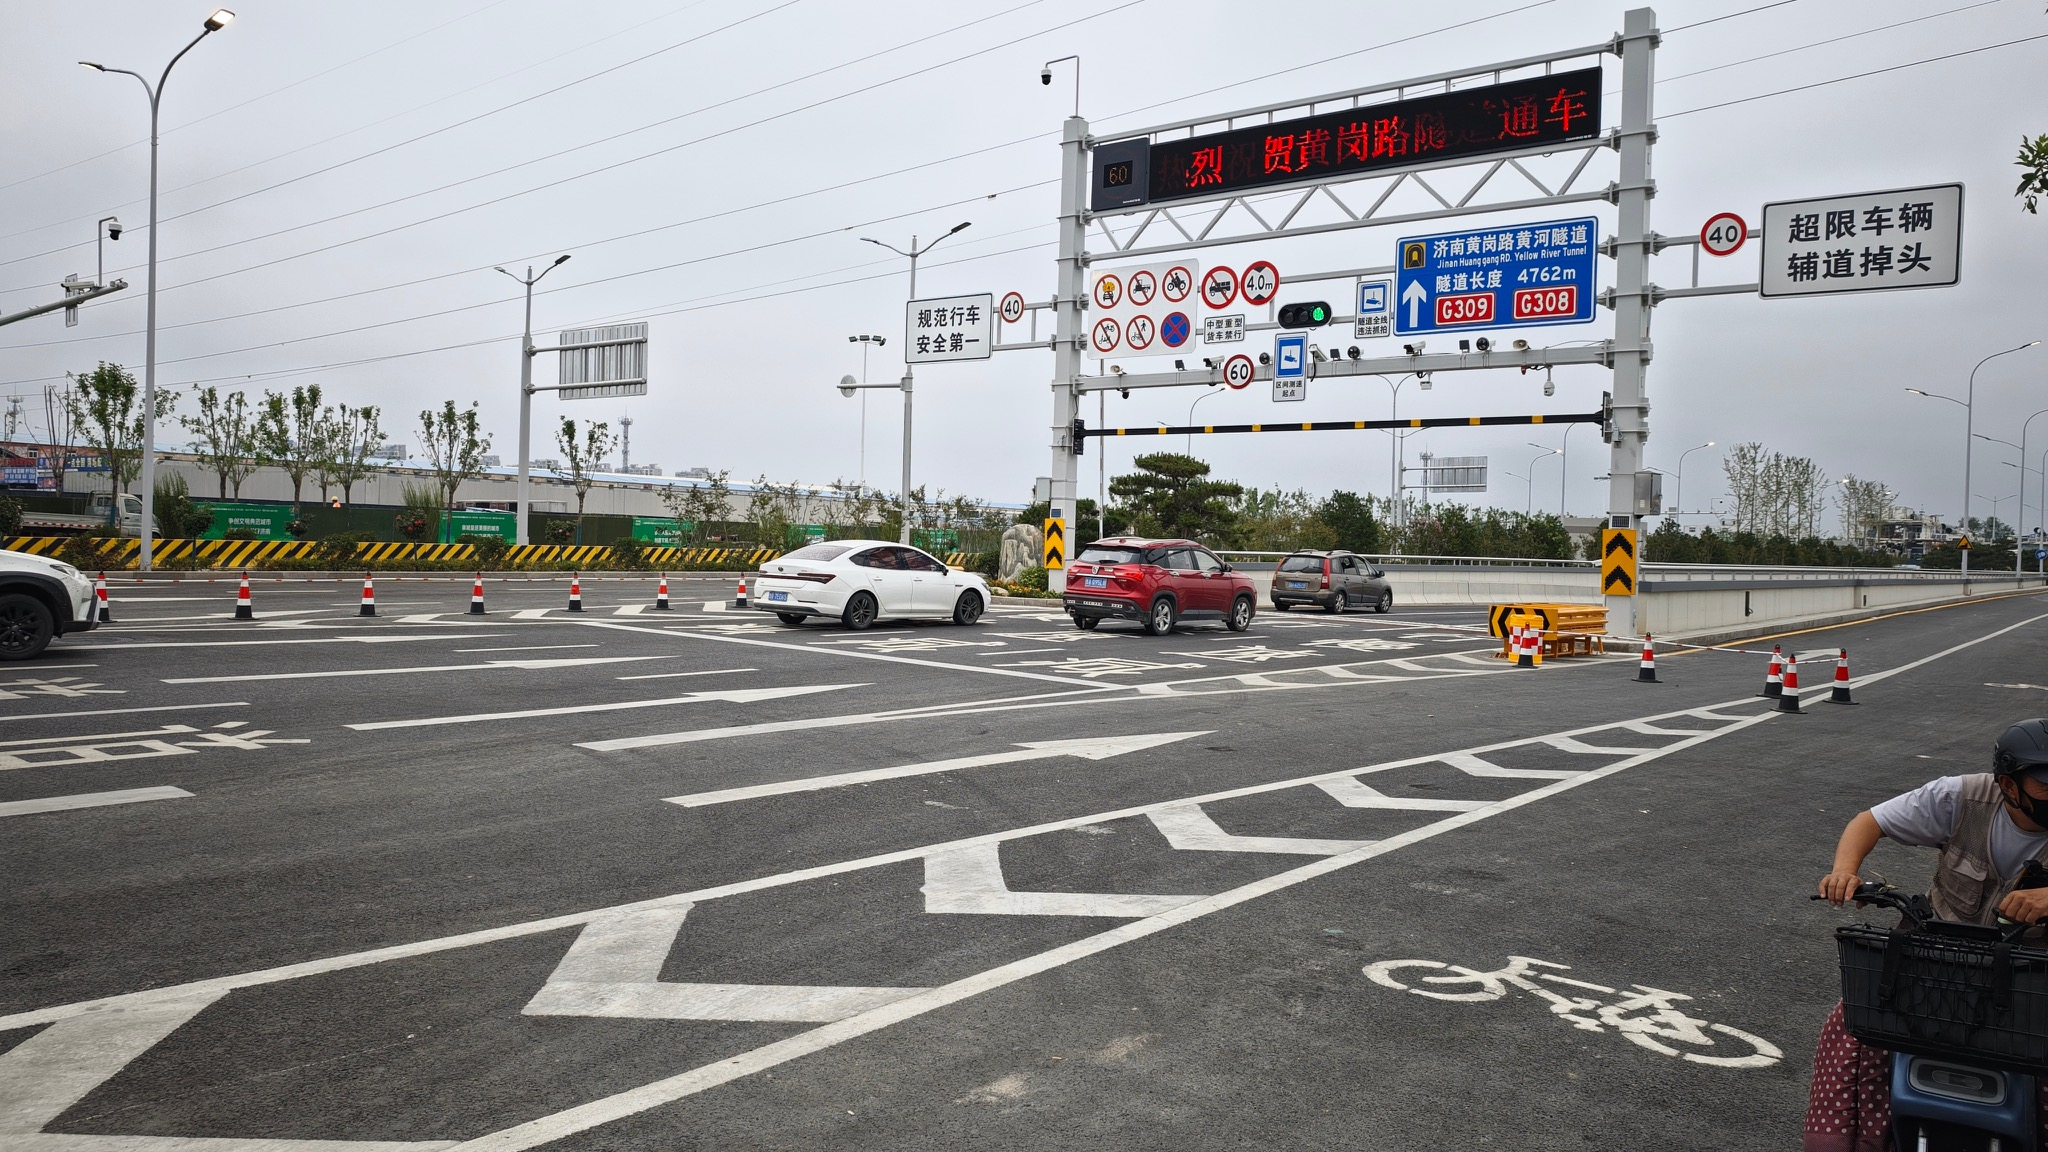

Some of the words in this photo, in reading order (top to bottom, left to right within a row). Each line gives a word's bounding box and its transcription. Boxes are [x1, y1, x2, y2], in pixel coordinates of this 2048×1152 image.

[1109, 165, 1128, 184] 60
[1788, 201, 1934, 243] 超限车辆
[1433, 224, 1588, 259] 济南黄岗路黄河隧道
[1708, 225, 1738, 244] 40
[1437, 259, 1458, 269] Jinan
[1500, 253, 1512, 263] RD.
[1514, 251, 1539, 261] Yellow
[1541, 248, 1561, 259] River
[1563, 245, 1587, 257] Tunnel
[1787, 242, 1932, 282] 辅道掉头
[1246, 274, 1273, 291] 4.0m
[1436, 269, 1503, 293] 隧道长度
[1517, 266, 1576, 284] 4762m
[917, 305, 980, 328] 规范行车
[1004, 300, 1020, 315] 40
[1442, 298, 1488, 320] G309
[1521, 291, 1569, 314] G308
[1207, 317, 1242, 329] 中型重型
[917, 332, 980, 354] 安全第一
[1207, 330, 1242, 341] 货车禁行
[1230, 364, 1249, 380] 60
